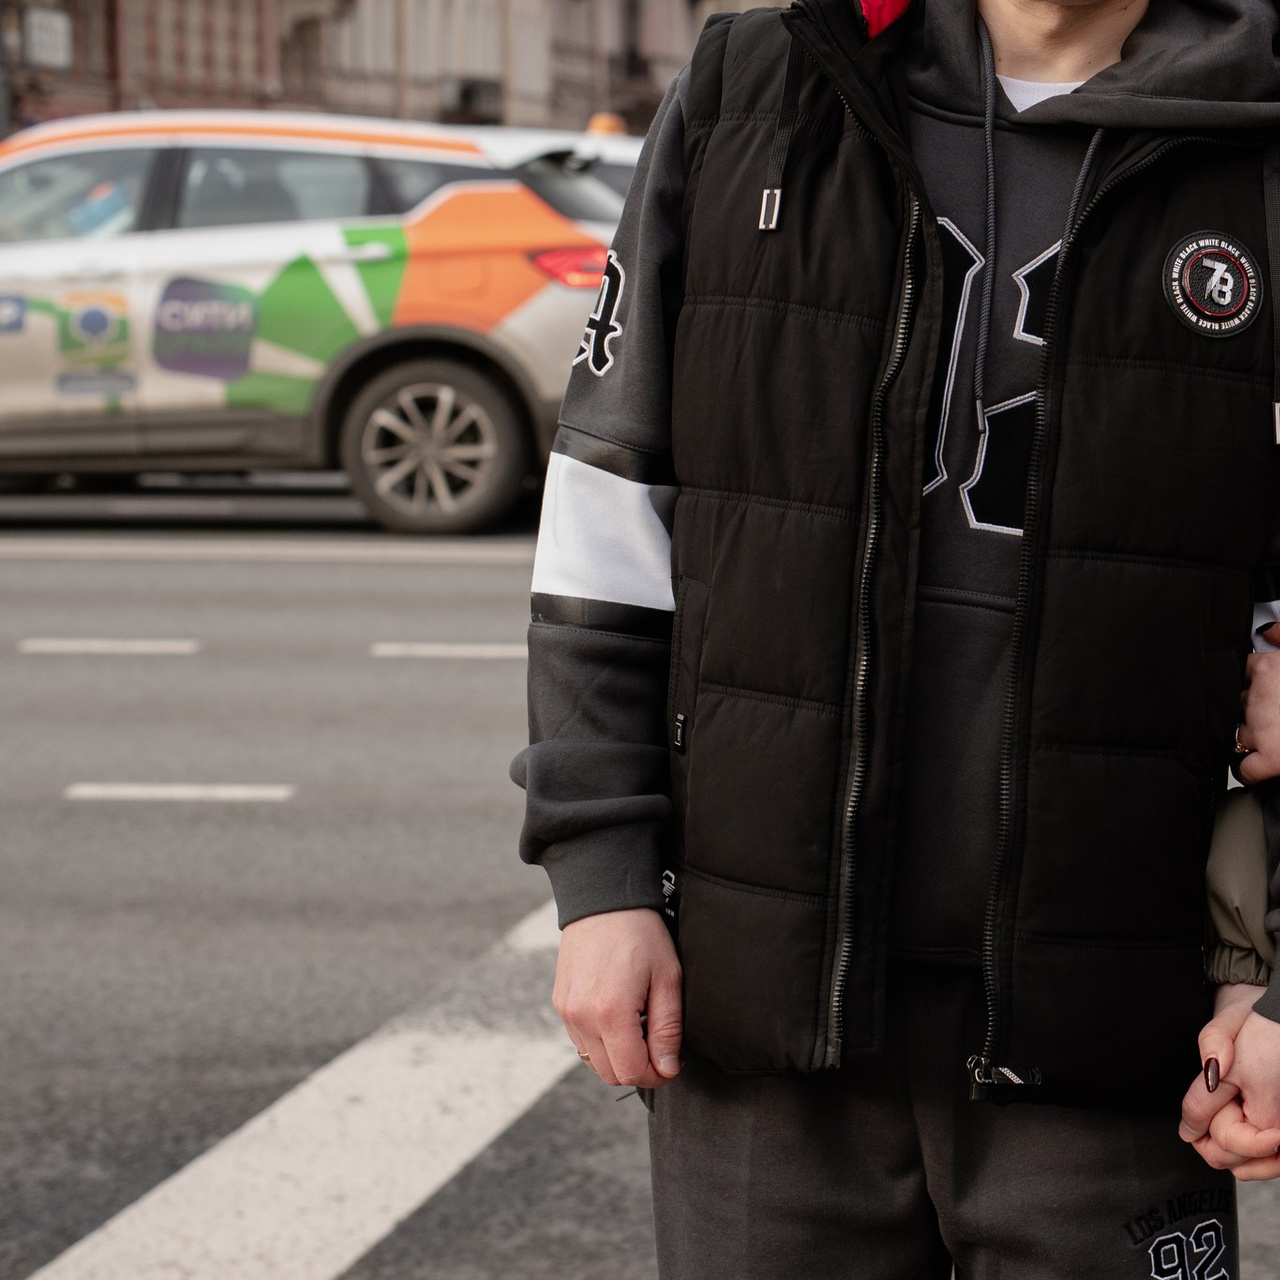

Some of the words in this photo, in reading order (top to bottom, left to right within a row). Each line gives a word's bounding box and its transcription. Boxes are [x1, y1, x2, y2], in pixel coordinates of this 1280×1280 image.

[1179, 242, 1199, 259] BLACK
[1198, 238, 1220, 247] WHITE
[1220, 240, 1241, 258] BLACK
[1171, 257, 1183, 279] WHITE
[1239, 255, 1255, 278] WHITE
[1171, 280, 1184, 304] BLACK
[1202, 258, 1234, 306] 78
[1248, 278, 1257, 303] BLACK
[1179, 303, 1198, 323] WHITE
[1238, 302, 1255, 321] BLACK
[1198, 319, 1220, 330] BLACK
[1220, 318, 1241, 330] WHITE
[1124, 1207, 1166, 1246] LOS
[1166, 1188, 1233, 1226] ANGELES
